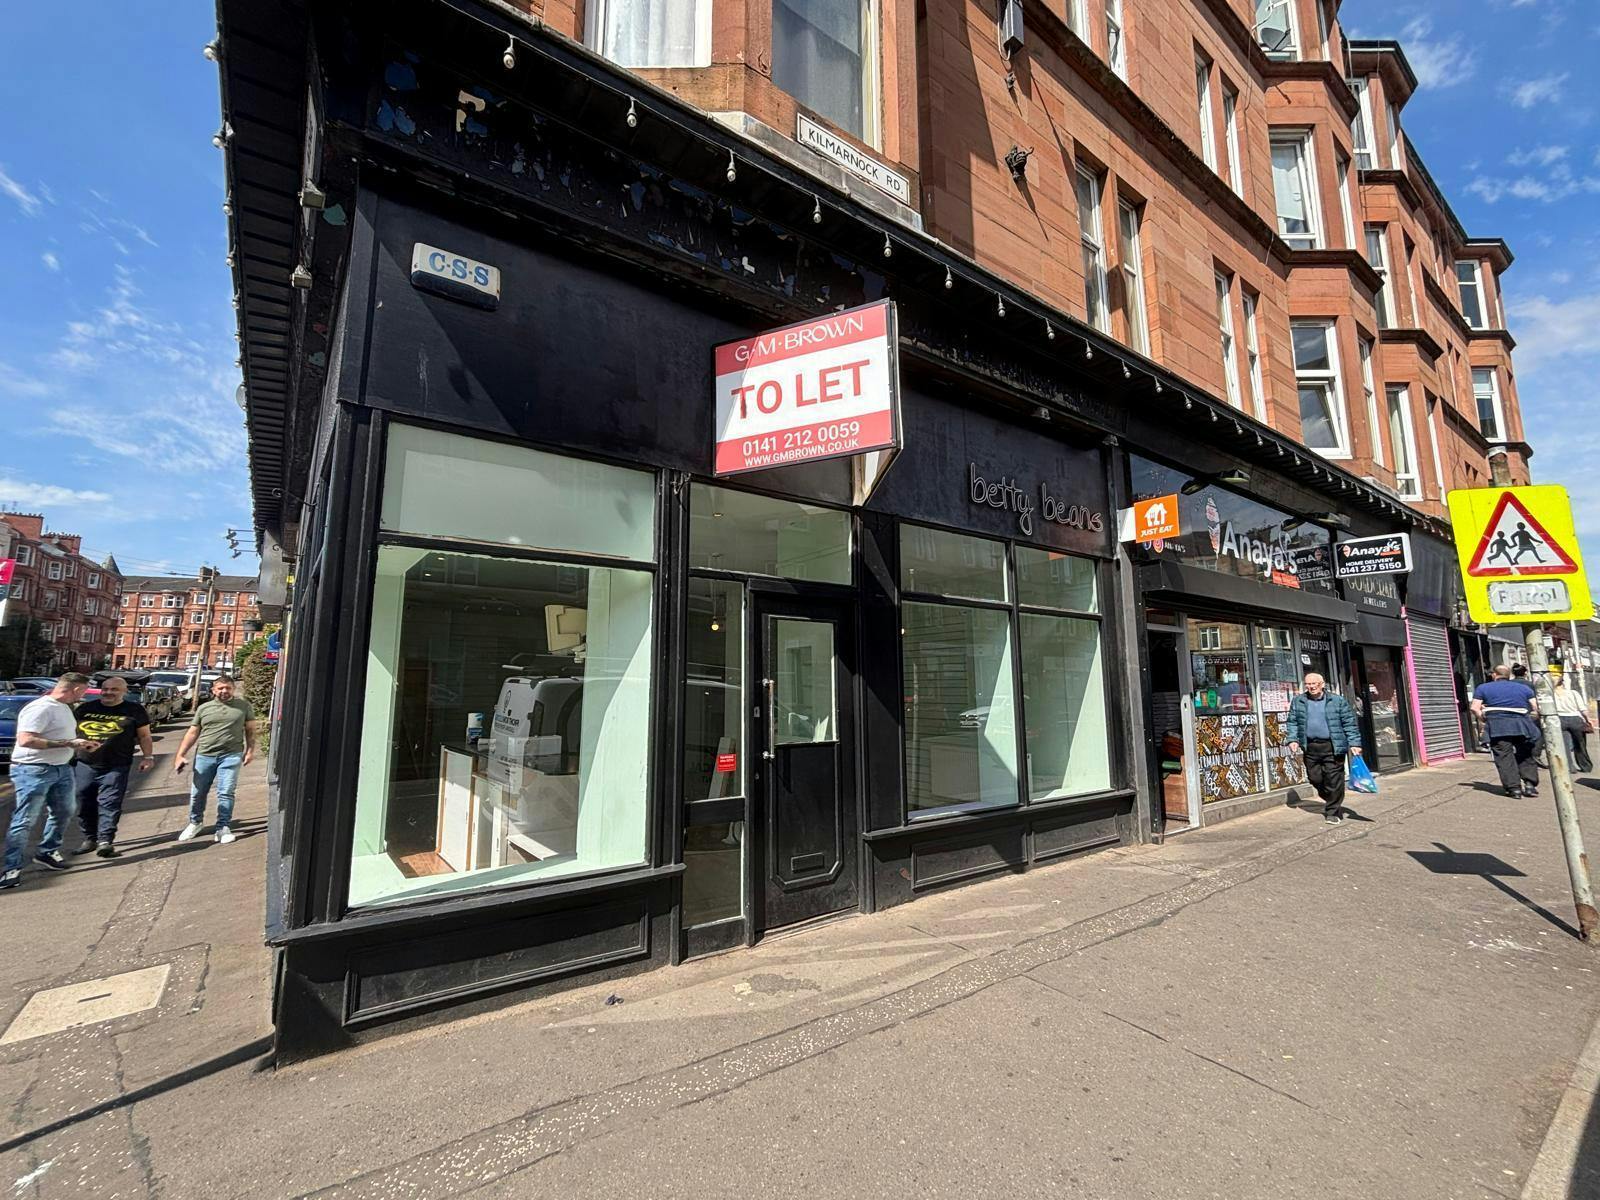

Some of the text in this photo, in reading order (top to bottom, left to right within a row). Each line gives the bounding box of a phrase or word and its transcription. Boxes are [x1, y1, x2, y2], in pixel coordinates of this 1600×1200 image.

[808, 128, 904, 194] KILMARNOCK RD.
[730, 359, 870, 419] TO LET
[742, 421, 860, 456] 0141 212 0059
[744, 439, 859, 467] WWW.GMBROWN.CO.UK
[970, 462, 1104, 536] betty beans
[1140, 525, 1174, 537] JUST EAT
[1340, 562, 1402, 574] 0141 237 5150
[1365, 557, 1394, 565] DELIVERY
[1363, 597, 1388, 609] JEWELLERS
[1221, 713, 1257, 727] PERI PERI
[1221, 726, 1235, 739] PERI
